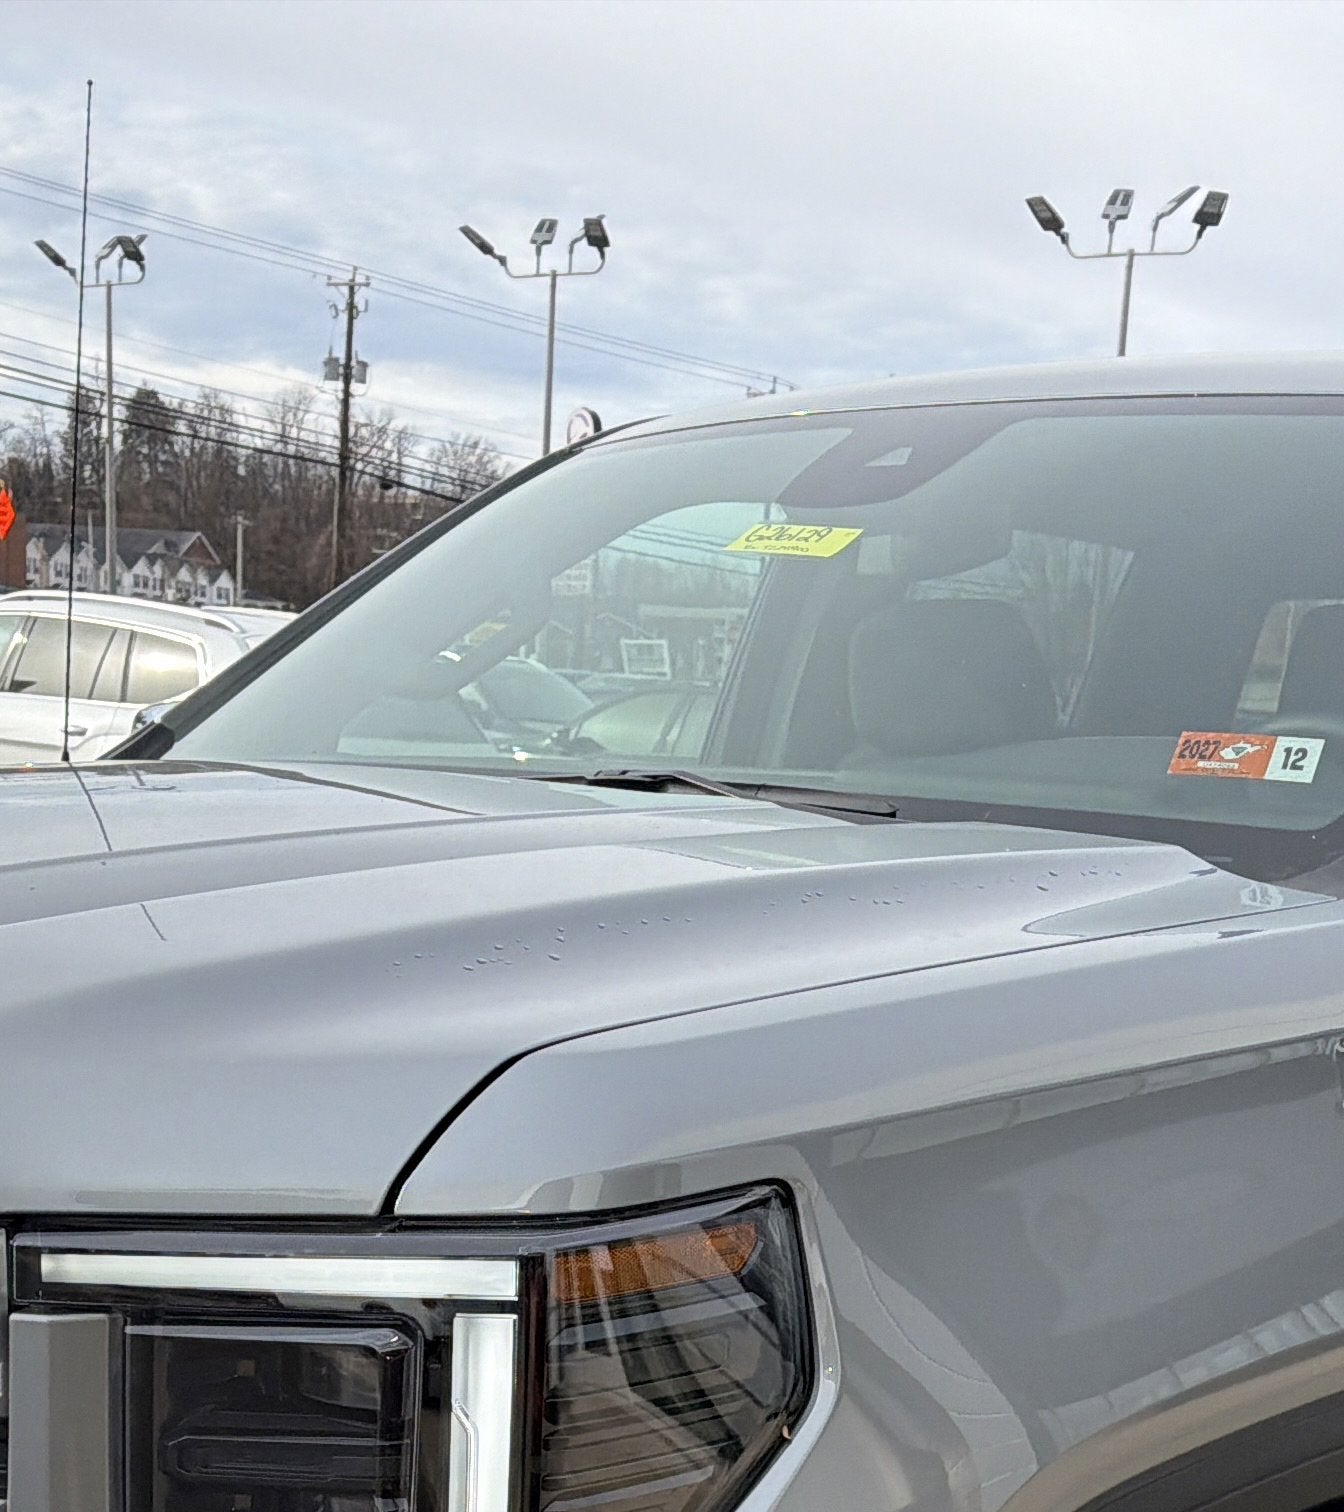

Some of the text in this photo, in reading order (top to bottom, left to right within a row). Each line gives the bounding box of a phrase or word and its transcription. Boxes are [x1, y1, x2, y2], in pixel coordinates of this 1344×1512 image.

[745, 525, 833, 543] G26129
[1177, 739, 1309, 771] 2027 12
